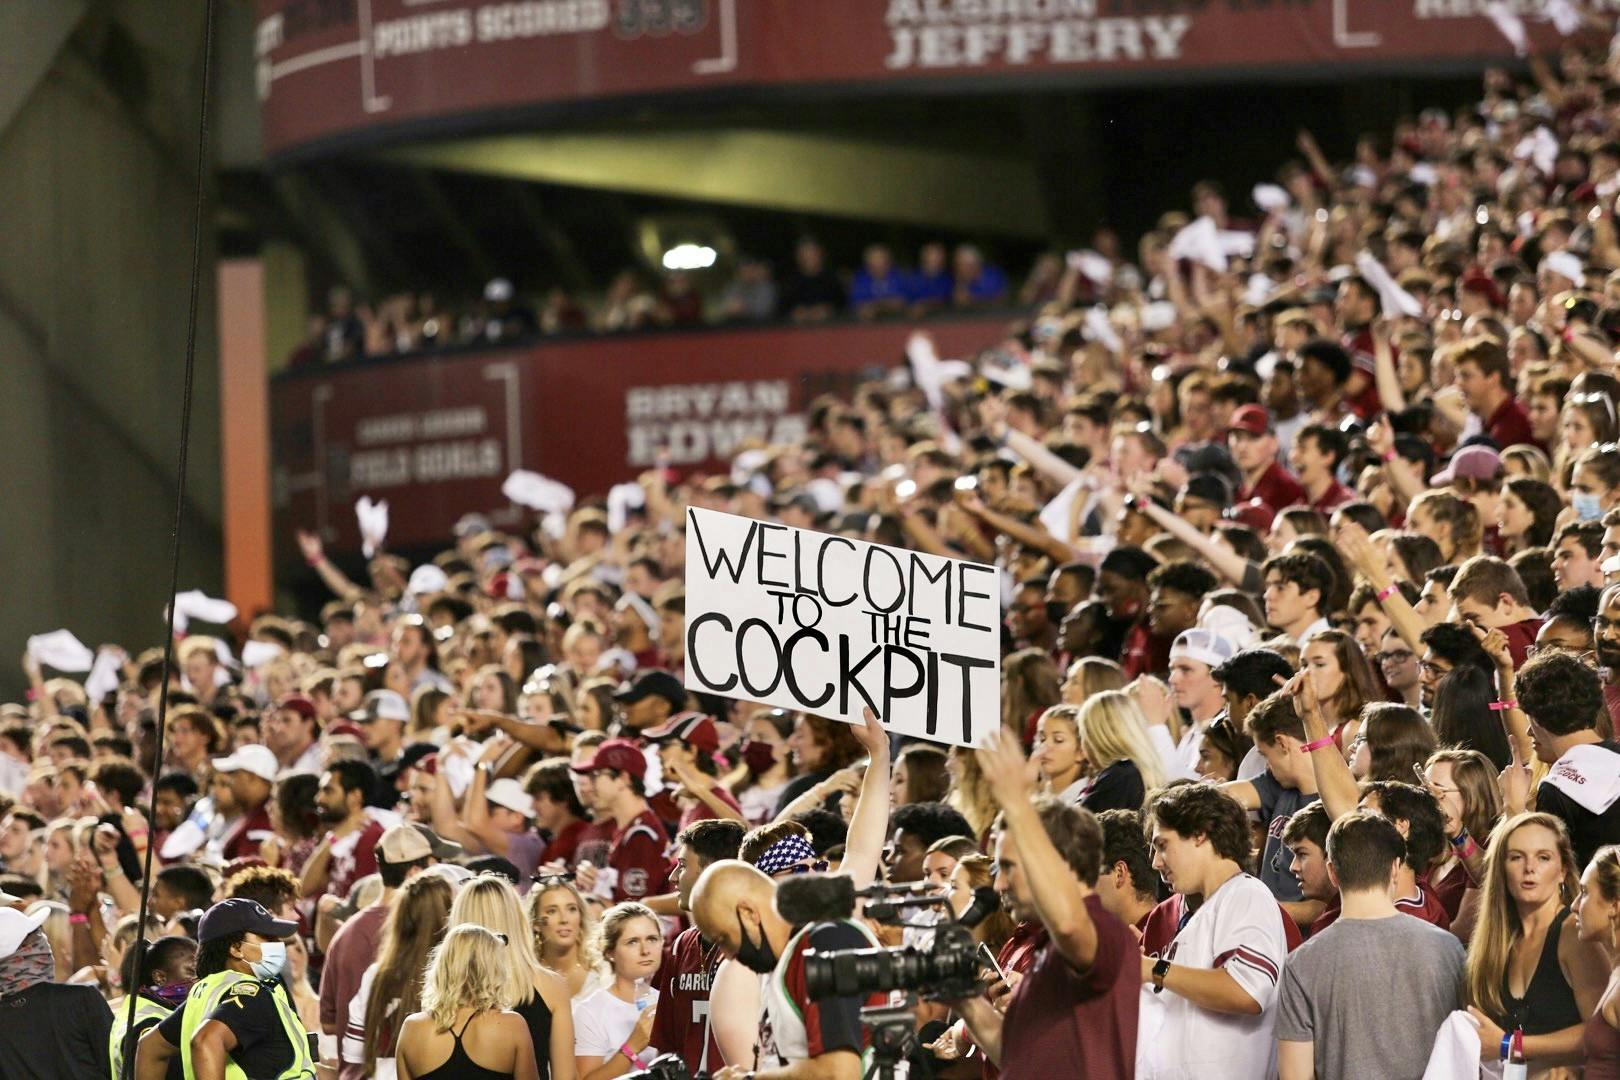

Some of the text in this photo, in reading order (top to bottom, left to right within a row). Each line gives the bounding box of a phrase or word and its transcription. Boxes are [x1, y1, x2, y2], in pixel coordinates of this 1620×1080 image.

[885, 15, 1192, 68] JEFFERY
[627, 380, 789, 420] BRYAN
[688, 507, 995, 632] WELCOME
[766, 589, 932, 651] TO THE
[687, 612, 995, 743] COCKPIT
